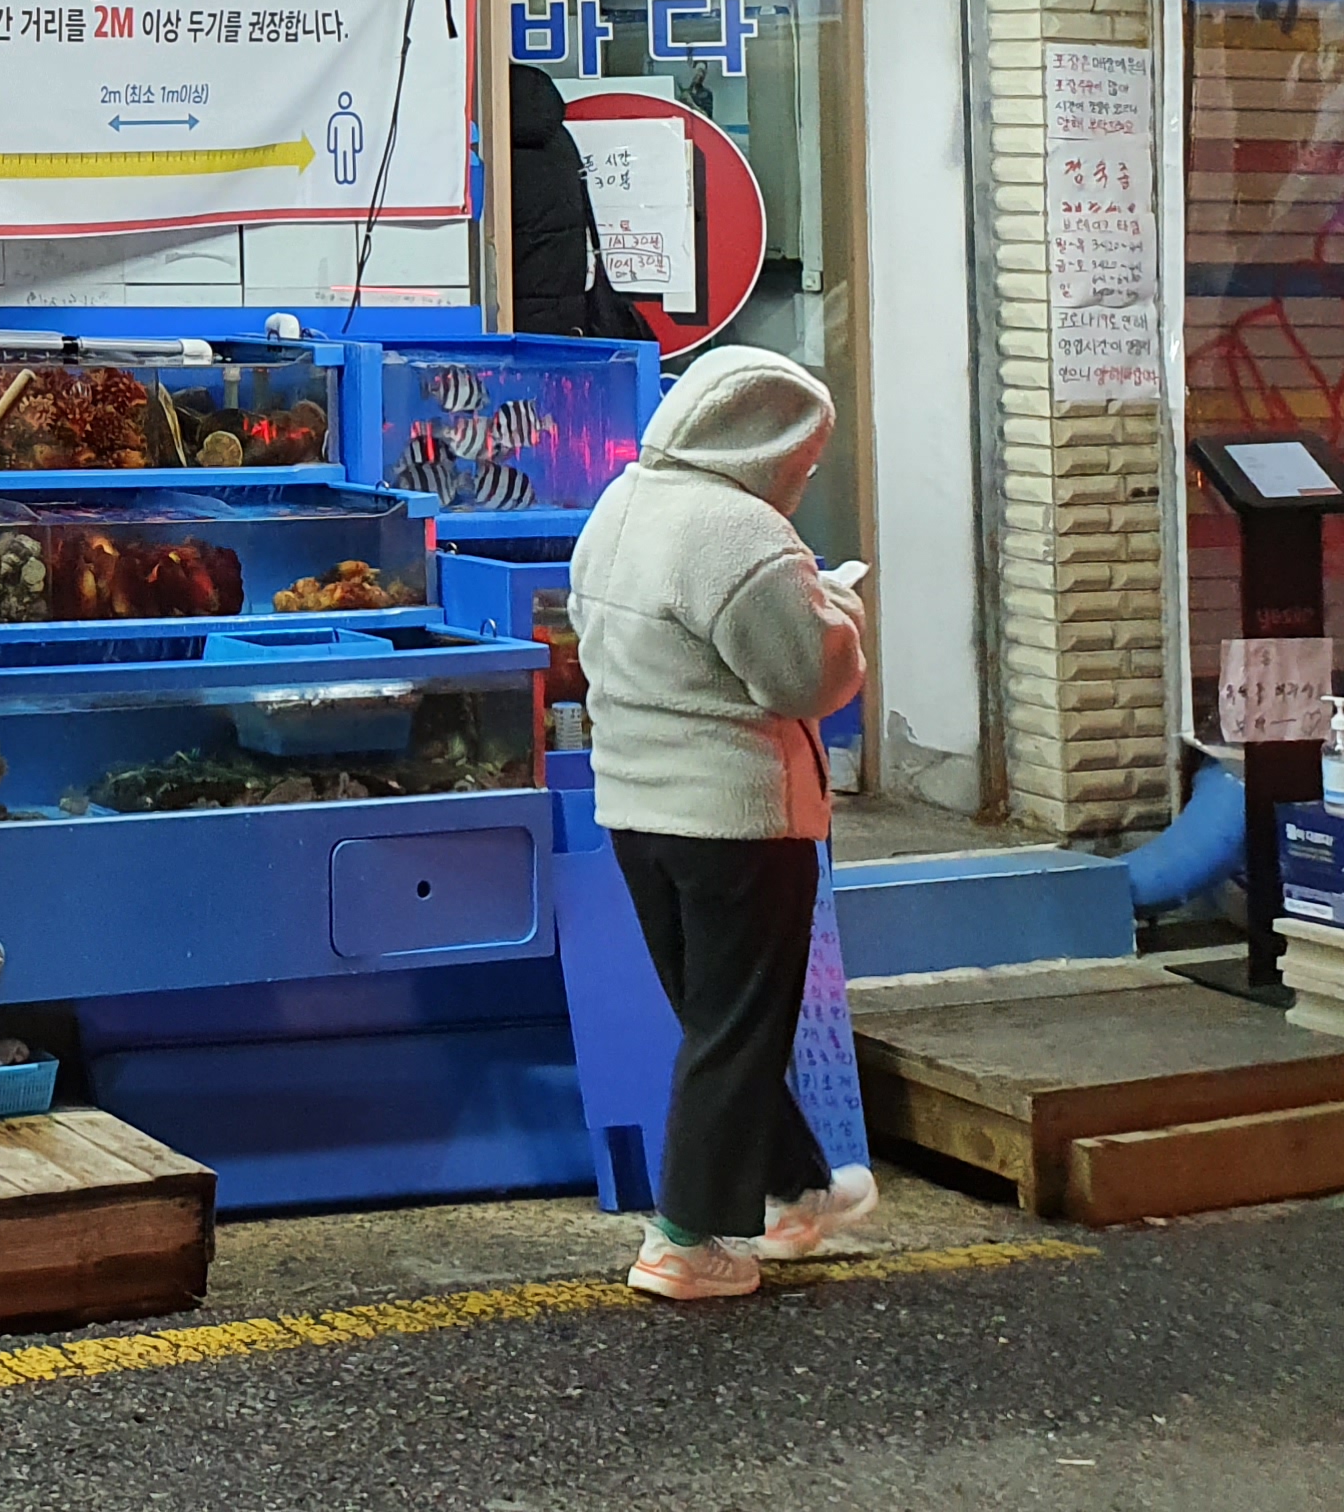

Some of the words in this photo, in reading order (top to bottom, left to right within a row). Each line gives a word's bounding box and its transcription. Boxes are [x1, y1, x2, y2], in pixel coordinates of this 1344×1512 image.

[20, 7, 86, 43] 거리를
[93, 5, 134, 39] 2M
[142, 9, 181, 43] 이상
[186, 9, 242, 43] 두기를
[248, 9, 349, 43] 권장합니다.
[100, 87, 121, 105] 2m
[124, 84, 156, 107] (최소
[160, 83, 210, 106] 1m이상)
